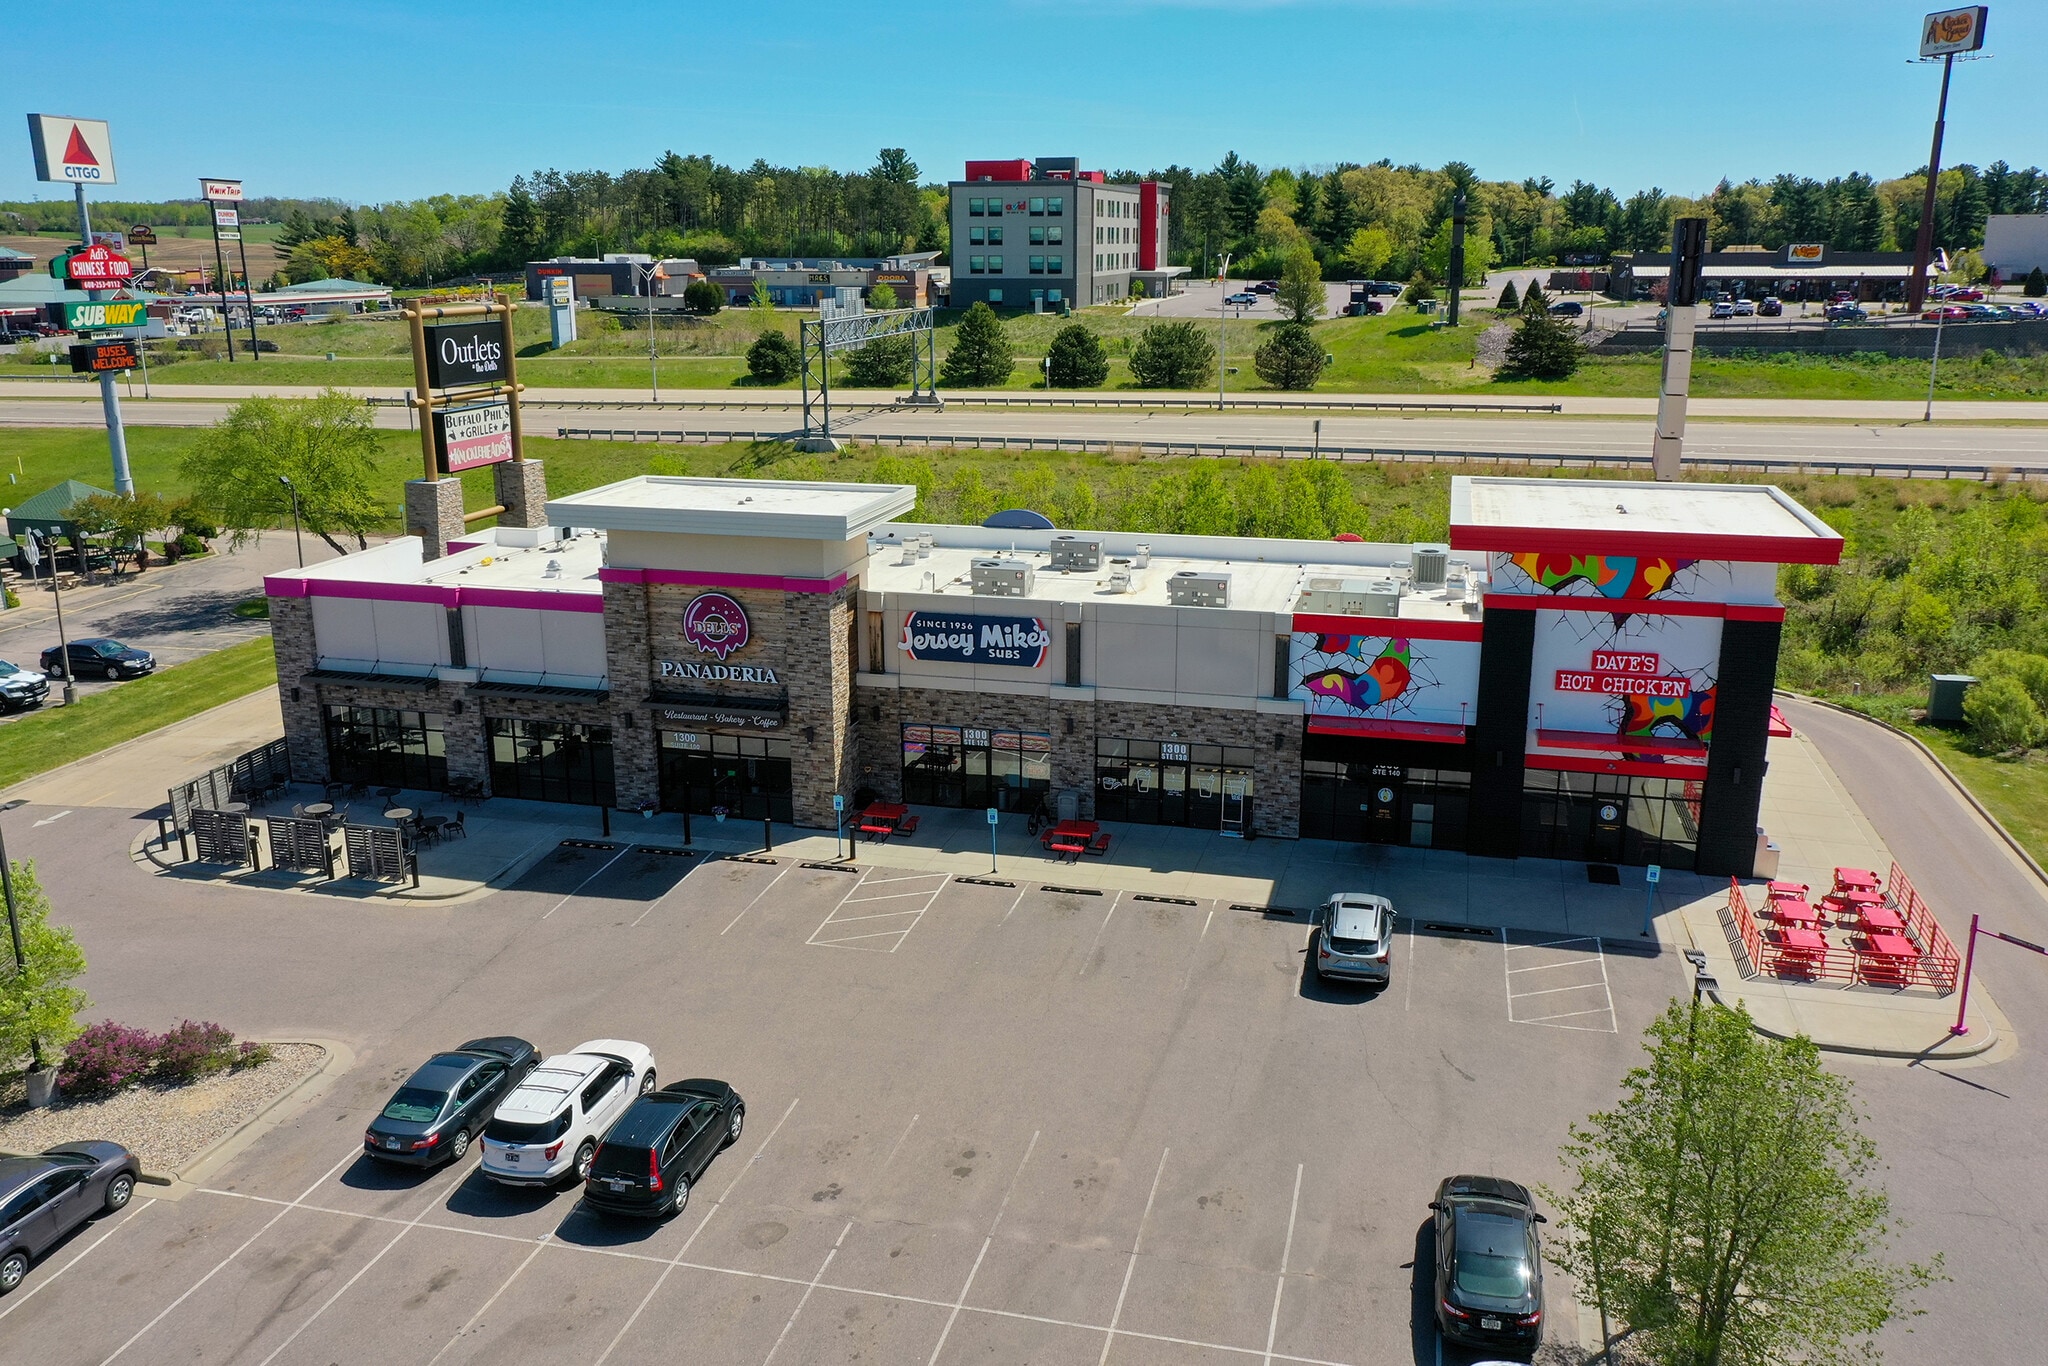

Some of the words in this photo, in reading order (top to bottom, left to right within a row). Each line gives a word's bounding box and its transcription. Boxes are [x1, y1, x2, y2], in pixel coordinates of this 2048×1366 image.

[64, 166, 101, 180] CITGO
[90, 248, 109, 260] Adi's
[72, 261, 106, 276] CHINESE
[109, 261, 130, 275] FOOD
[71, 304, 143, 327] SUBWAY
[97, 345, 128, 359] BUSES
[441, 334, 501, 365] Outlets
[91, 355, 136, 370] WELCOME
[465, 423, 494, 438] GRILLE
[693, 620, 738, 635] DELLS
[916, 620, 946, 628] SINCE
[950, 622, 973, 630] 1956
[898, 626, 975, 656] Jersey
[980, 624, 1050, 649] Mike's
[989, 649, 1020, 659] SUBS
[1595, 655, 1656, 672] DAVE'S
[661, 662, 778, 684] PANADERIA
[1560, 673, 1594, 690] HOT
[1602, 677, 1686, 697] CHICKEN
[664, 709, 708, 721] Restaurant
[715, 713, 745, 726] Bakery
[752, 715, 779, 728] Coffee
[674, 733, 696, 743] 1300
[964, 730, 987, 740] 1300
[1161, 743, 1187, 754] 1300
[1372, 768, 1387, 776] STE
[1388, 769, 1401, 777] 140
